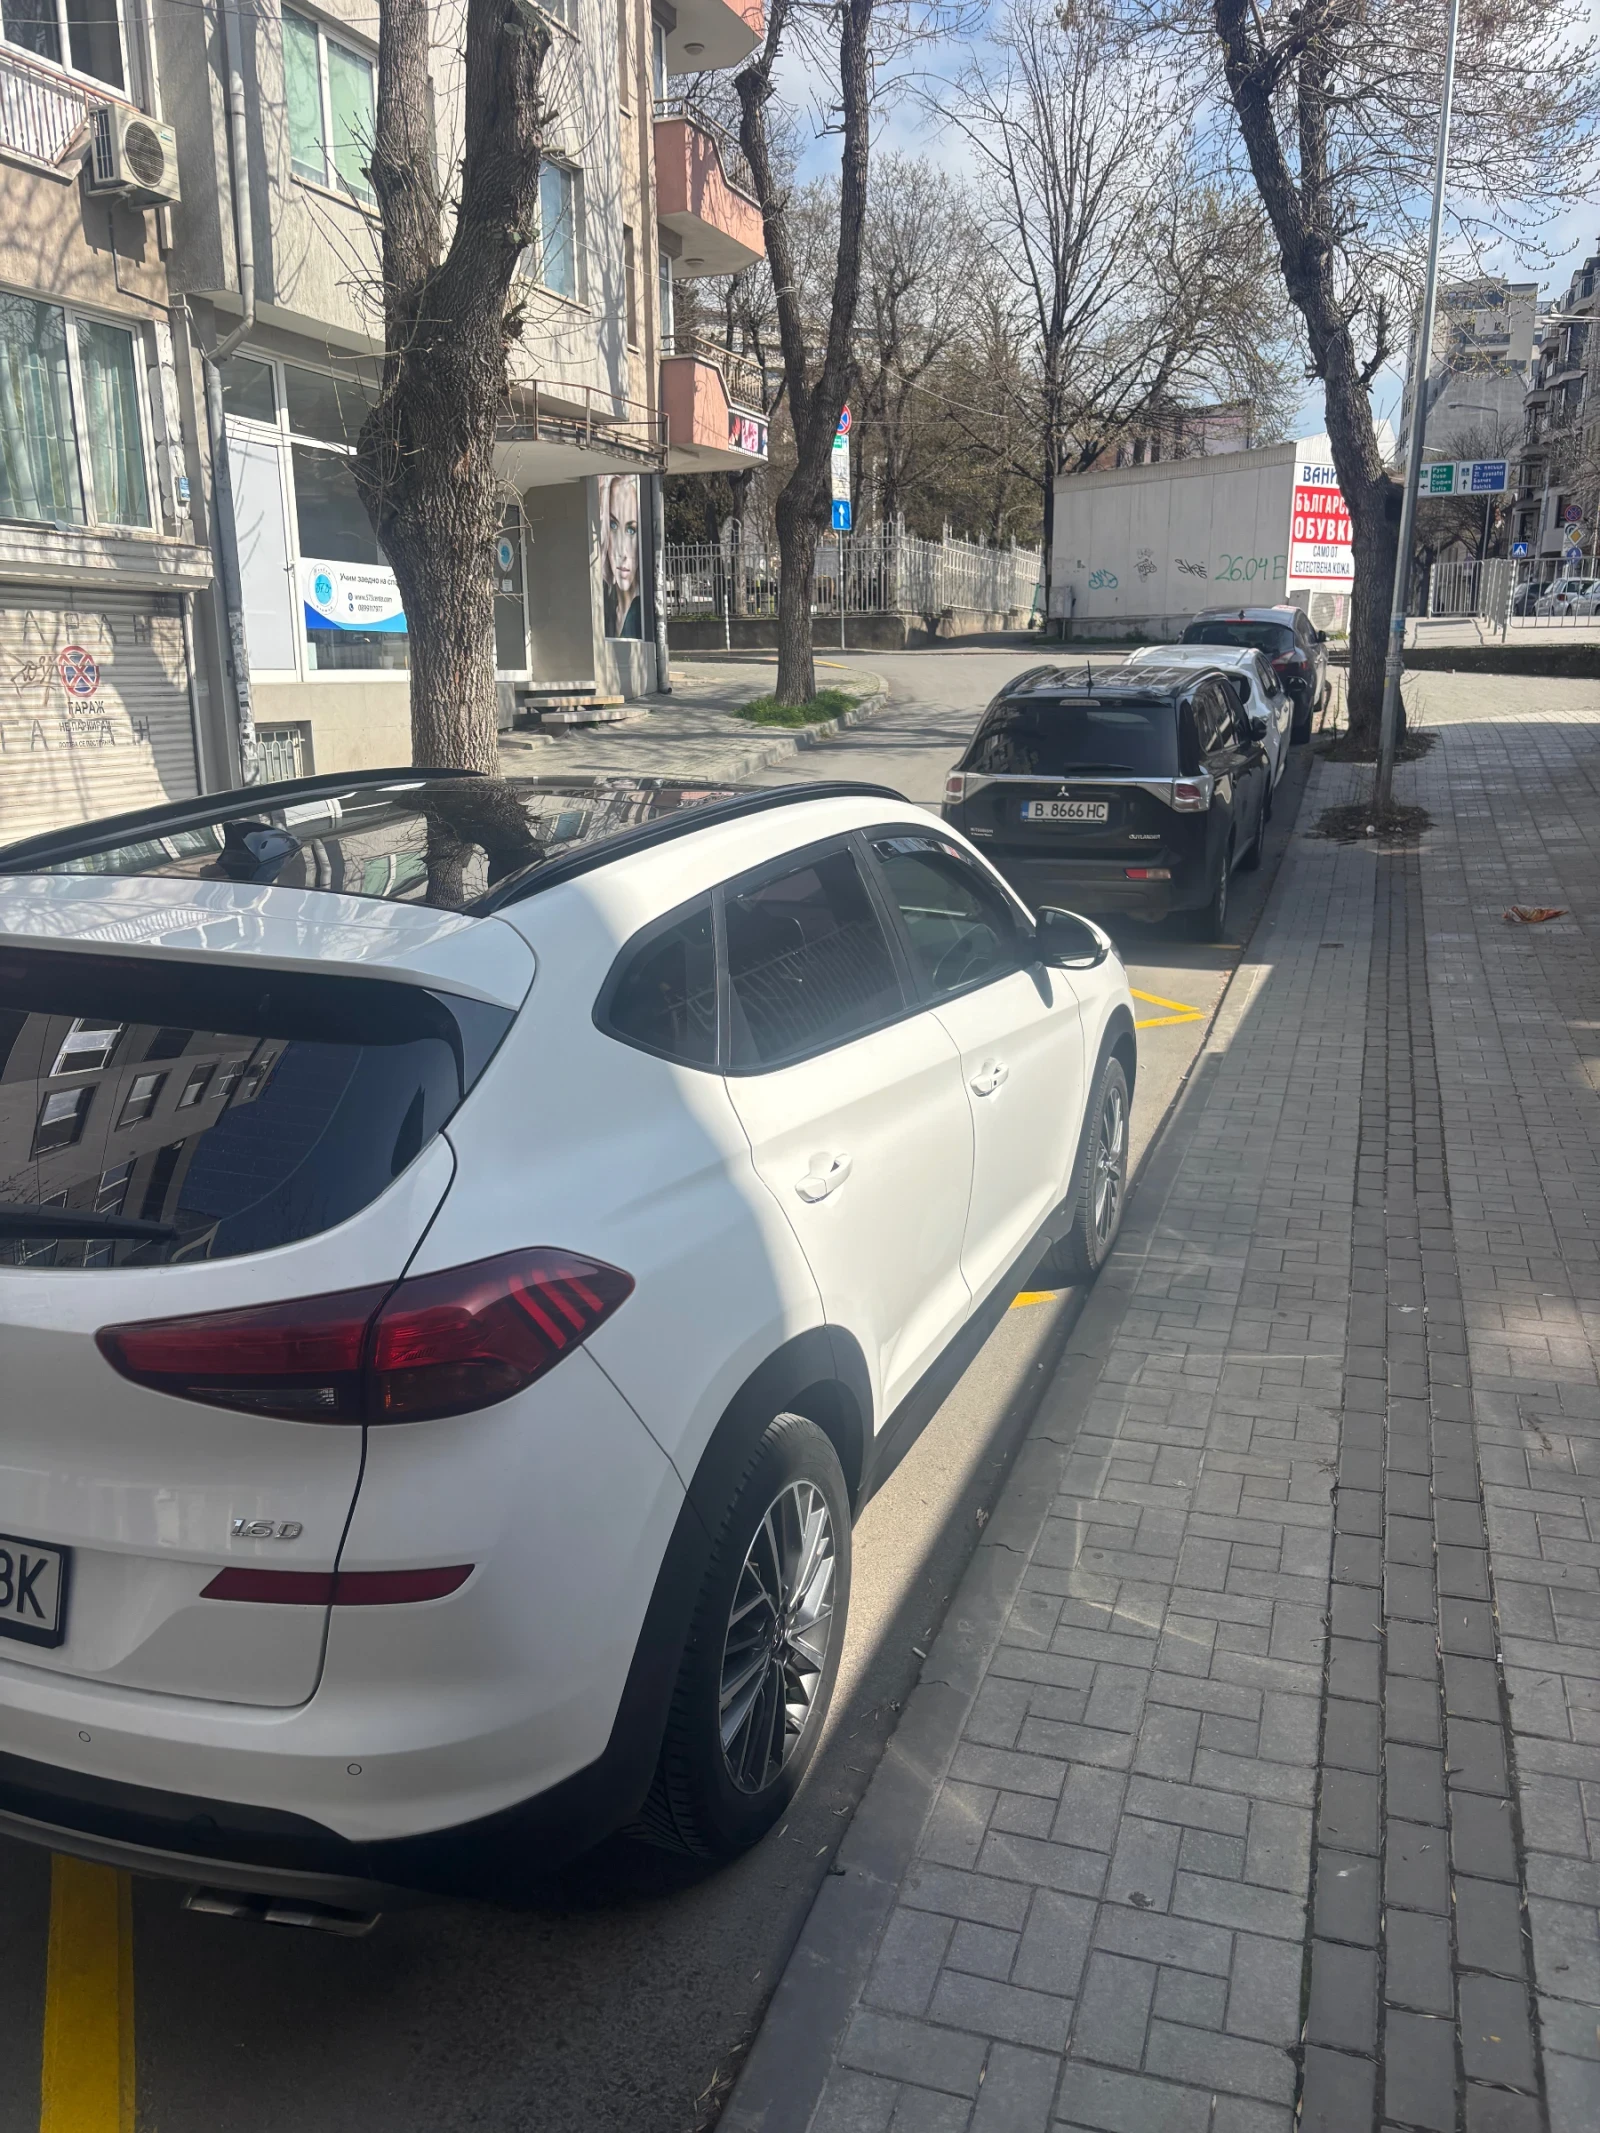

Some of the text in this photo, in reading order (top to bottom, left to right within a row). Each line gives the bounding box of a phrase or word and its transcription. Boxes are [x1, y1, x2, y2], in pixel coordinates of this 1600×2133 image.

[1295, 493, 1349, 515] БЪЛГАРС
[1313, 545, 1338, 558] САМО ОТ
[1295, 560, 1350, 574] ЕСТЕСТВЕНА КОЖА
[340, 573, 357, 581] Учим
[357, 576, 380, 584] заедно
[67, 700, 105, 714] ГАРАЖ
[1034, 803, 1106, 819] B 8666 HC
